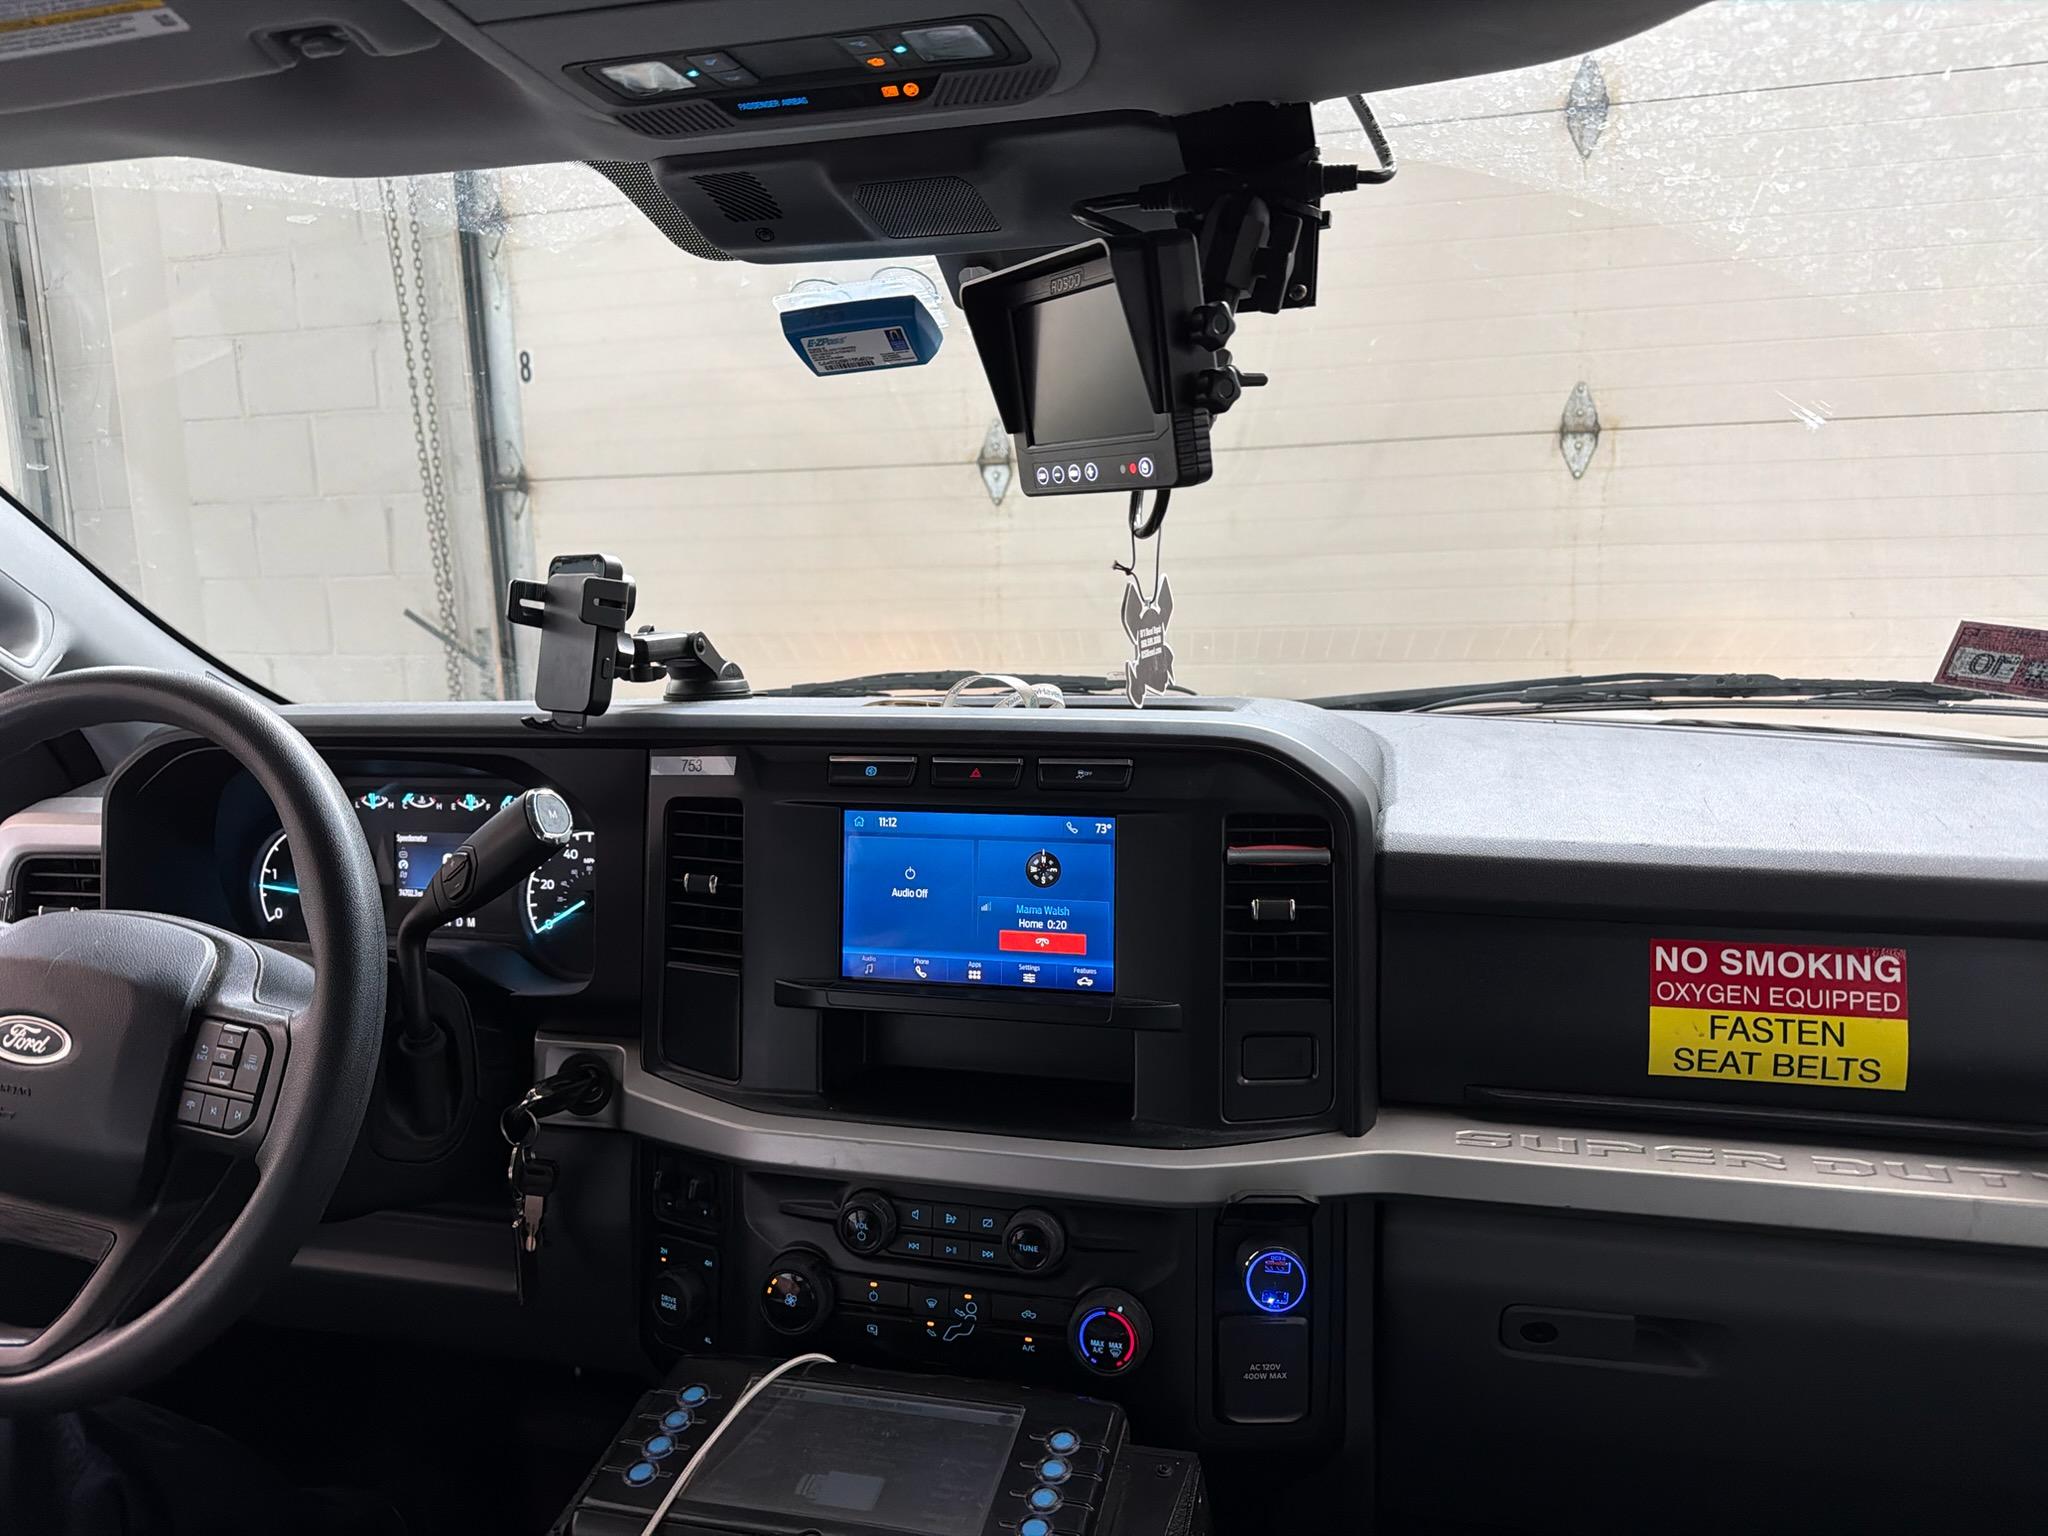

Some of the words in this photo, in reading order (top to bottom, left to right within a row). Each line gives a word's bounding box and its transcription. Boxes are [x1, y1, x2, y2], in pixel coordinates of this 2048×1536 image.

[737, 99, 780, 111] PASSENGER
[781, 96, 808, 106] AIRBAG
[520, 351, 531, 383] 8
[681, 759, 702, 772] 753
[878, 817, 898, 828] 11:12
[1095, 823, 1112, 834] 73°
[563, 848, 578, 860] 40
[272, 868, 277, 880] 1
[541, 878, 555, 890] 20
[891, 887, 914, 898] Audio
[915, 888, 929, 899] Off
[275, 907, 283, 919] 0
[1016, 904, 1042, 915] Mama
[1044, 905, 1070, 917] Walsh
[1018, 918, 1043, 929] Home
[1047, 919, 1068, 930] 0:20
[913, 957, 930, 965] Phone
[968, 961, 982, 969] Apps
[1655, 946, 1708, 974] NO
[1720, 948, 1902, 983] SMOKING
[1018, 963, 1041, 973] Settings
[1073, 967, 1097, 975] Features
[1656, 981, 1760, 1006] OXYGEN
[1769, 987, 1901, 1012] EQUIPPED
[1709, 1015, 1845, 1047] FASTEN
[2, 1023, 51, 1054] Ford
[1673, 1047, 1762, 1076] SEAT
[1772, 1053, 1881, 1083] BELTS
[1455, 1129, 1787, 1172] SUPER
[1017, 1243, 1039, 1253] TUNE
[661, 1293, 677, 1303] DRIVE
[661, 1300, 677, 1311] MODE
[1022, 1344, 1036, 1352] A/C
[1090, 1339, 1105, 1347] MAX
[1108, 1341, 1123, 1349] MAX
[1092, 1346, 1104, 1354] A/C
[1249, 1363, 1261, 1371] AC
[1262, 1363, 1281, 1371] 120V
[1243, 1372, 1267, 1380] 400W
[1269, 1372, 1288, 1380] MAX
